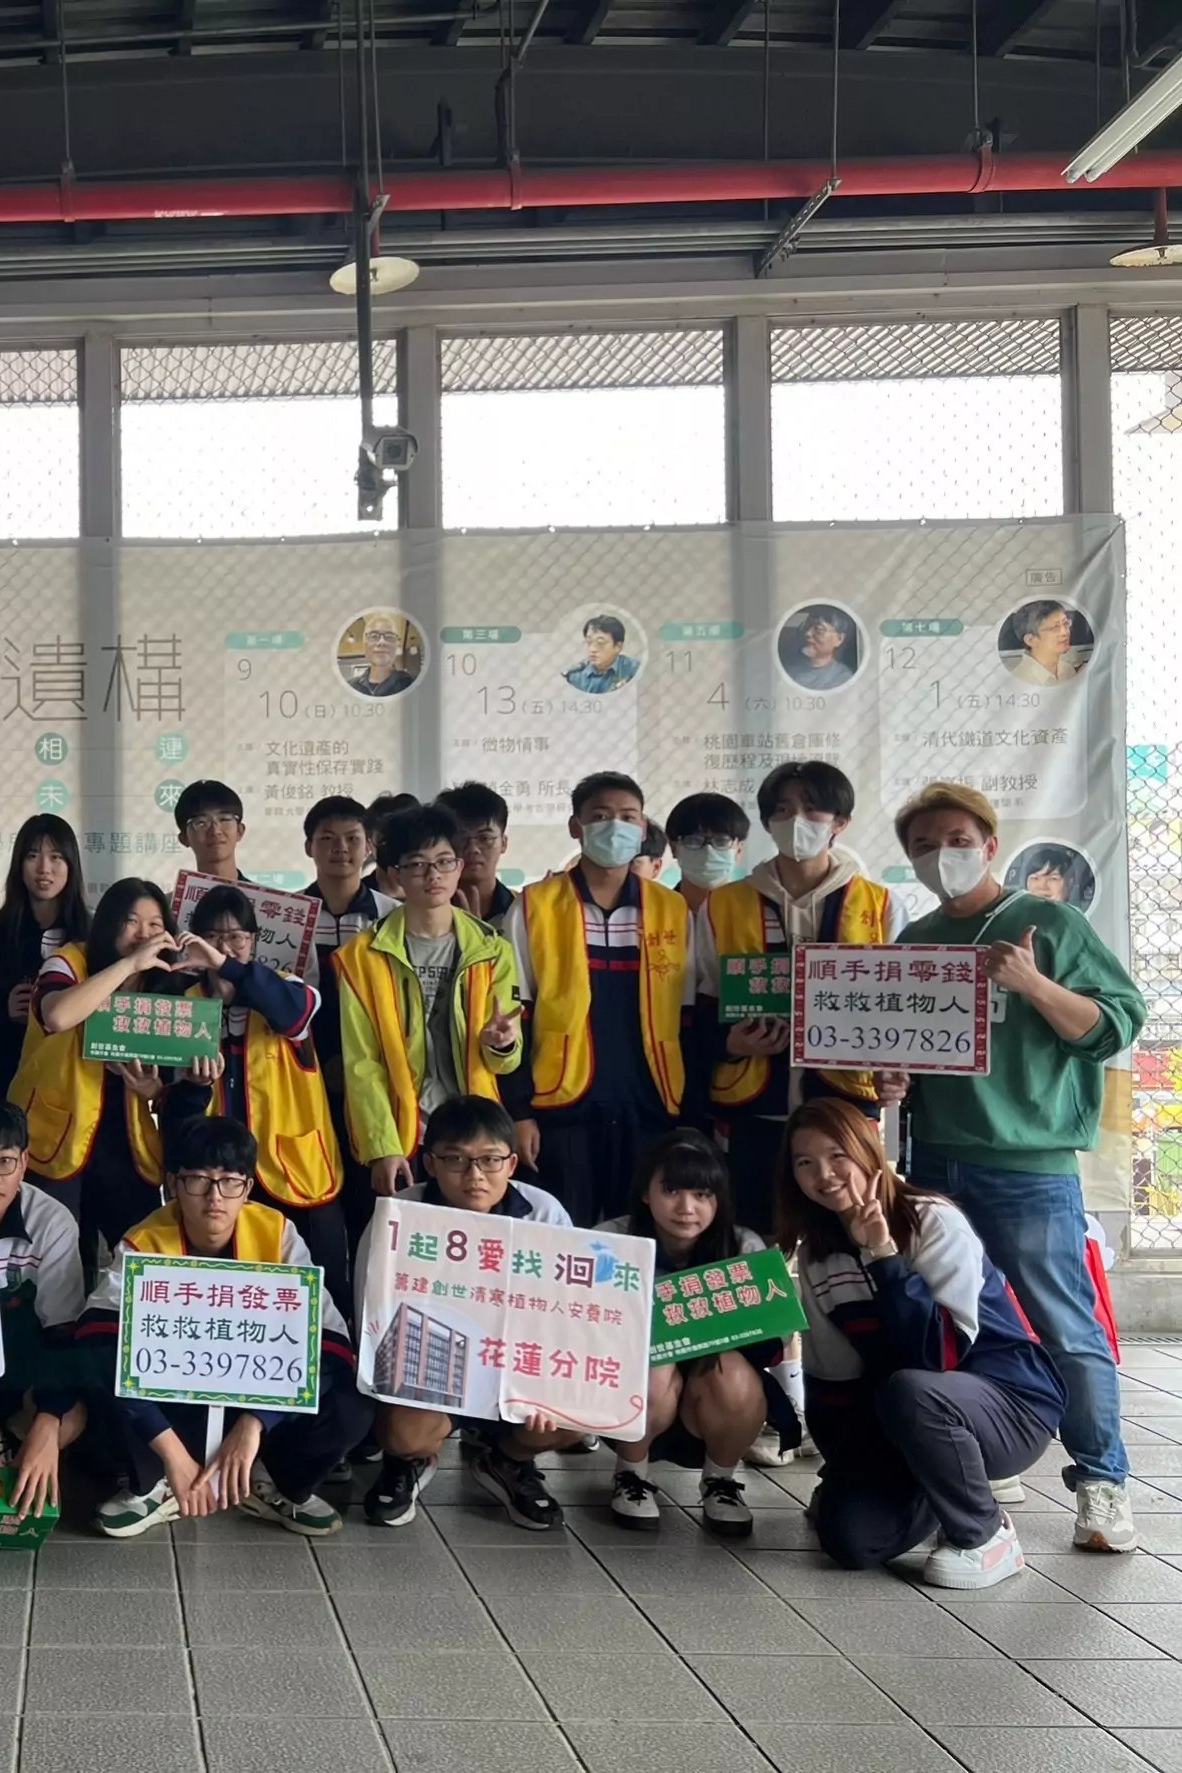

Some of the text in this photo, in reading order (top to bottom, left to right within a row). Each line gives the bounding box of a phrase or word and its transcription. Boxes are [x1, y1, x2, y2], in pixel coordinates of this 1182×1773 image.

[1029, 572, 1059, 585] 廣告
[237, 659, 252, 681] 9
[447, 654, 477, 676] 10
[665, 650, 694, 673] 11
[885, 646, 917, 670] 12
[259, 690, 299, 719] 10
[477, 685, 516, 714] 13
[706, 682, 730, 711] 4
[929, 681, 943, 709] 1
[265, 740, 349, 756] 文化遺產的
[482, 737, 549, 755] 微物情事
[922, 727, 1069, 748] 清代鐵道文化資產
[538, 780, 572, 797] 所長
[981, 773, 1038, 792] 副教授
[807, 959, 975, 984] 順手捐零錢
[813, 991, 970, 1014] 救救植物人
[113, 1014, 212, 1040] 救救植物人
[807, 1024, 972, 1054] 03-3397826
[140, 1279, 303, 1313] 順手捐發票
[394, 1272, 624, 1327] 籌建創世清寒植物人安養院
[662, 1278, 788, 1327] 救救植物人
[140, 1313, 300, 1345] 救救植物人
[135, 1347, 304, 1384] 03-3397826
[478, 1337, 622, 1389] 花蓮分院
